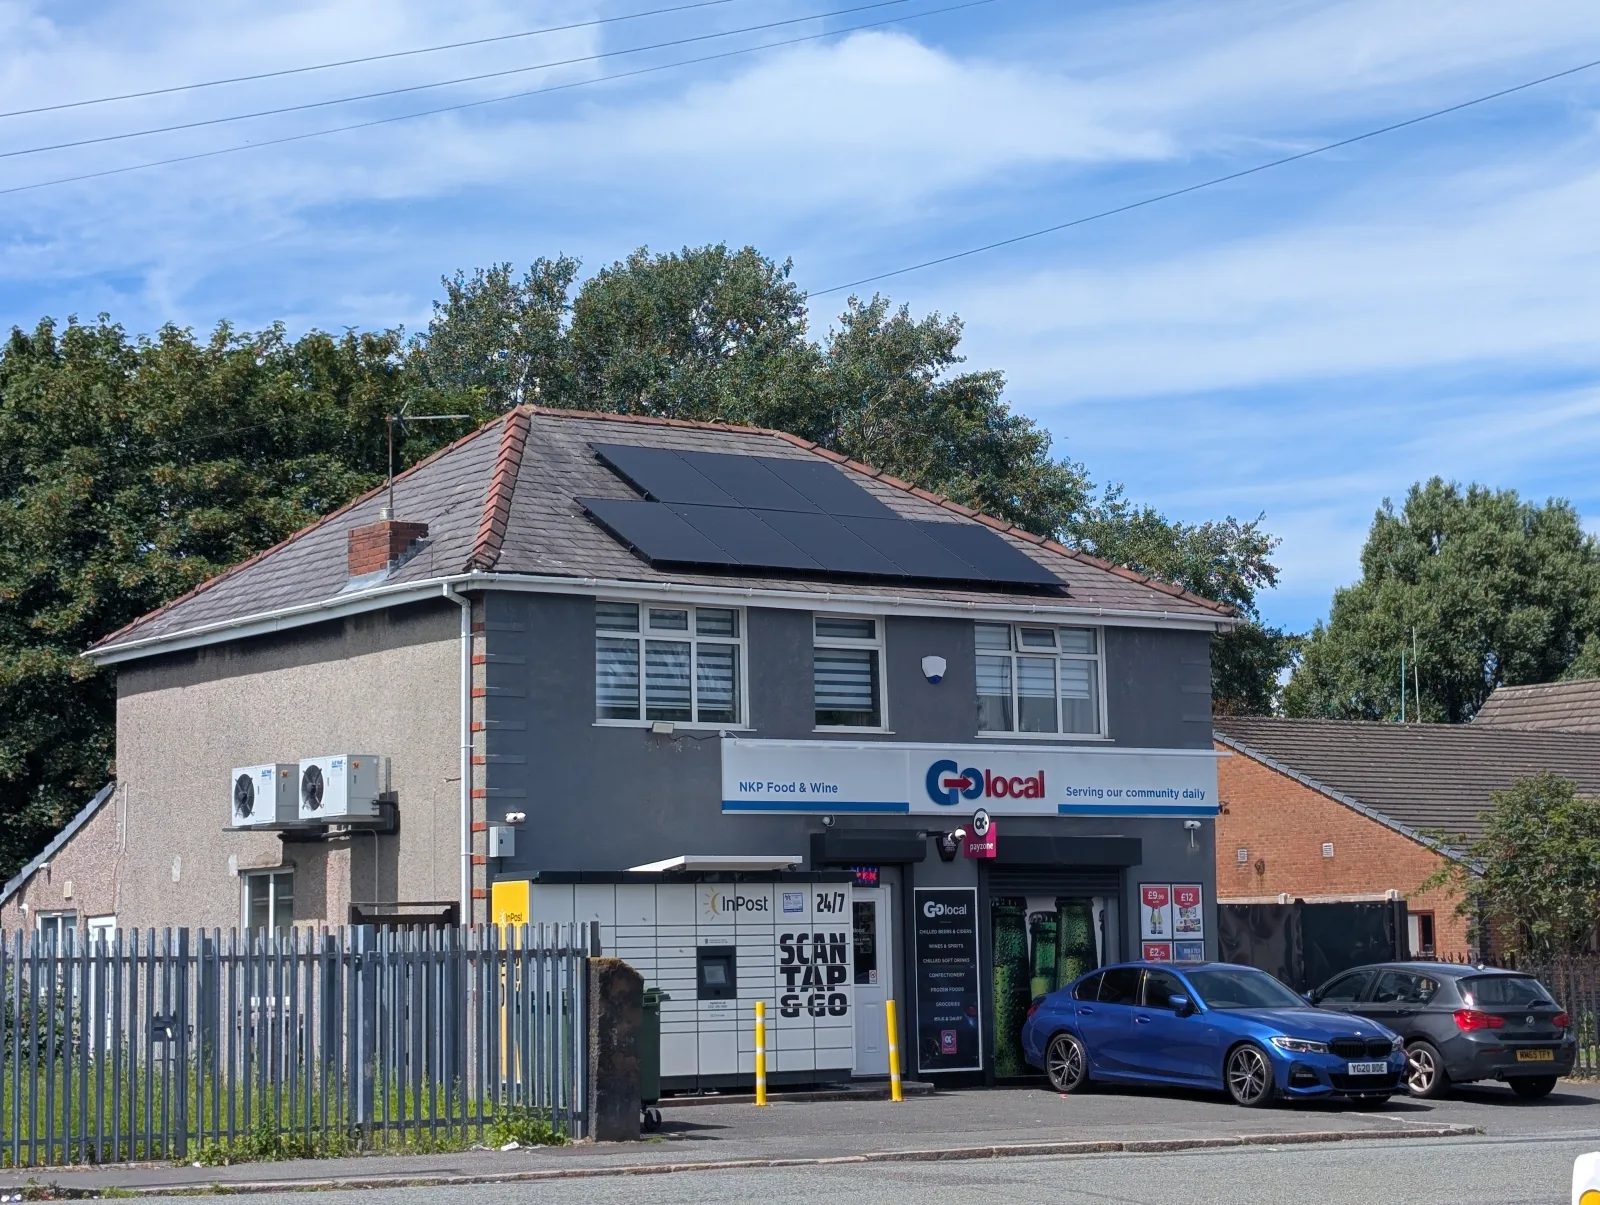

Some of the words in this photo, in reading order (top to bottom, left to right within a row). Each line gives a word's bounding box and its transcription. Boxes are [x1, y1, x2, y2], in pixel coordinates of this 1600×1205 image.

[739, 781, 764, 793] NKP
[767, 781, 796, 793] Food
[798, 782, 807, 793] &
[809, 782, 838, 794] Wine
[1066, 786, 1104, 799] Serving
[1106, 788, 1123, 798] our
[1125, 787, 1180, 800] community
[1182, 788, 1206, 800] daily
[969, 841, 994, 853] payzone
[722, 895, 769, 912] InPost
[816, 891, 846, 914] 24/7
[1181, 893, 1194, 902] £12
[505, 912, 523, 922] InPost
[779, 932, 847, 965] SCAN
[779, 965, 847, 993] TAP
[780, 994, 803, 1018] &
[807, 993, 848, 1017] GO
[1351, 1063, 1370, 1073] YG20
